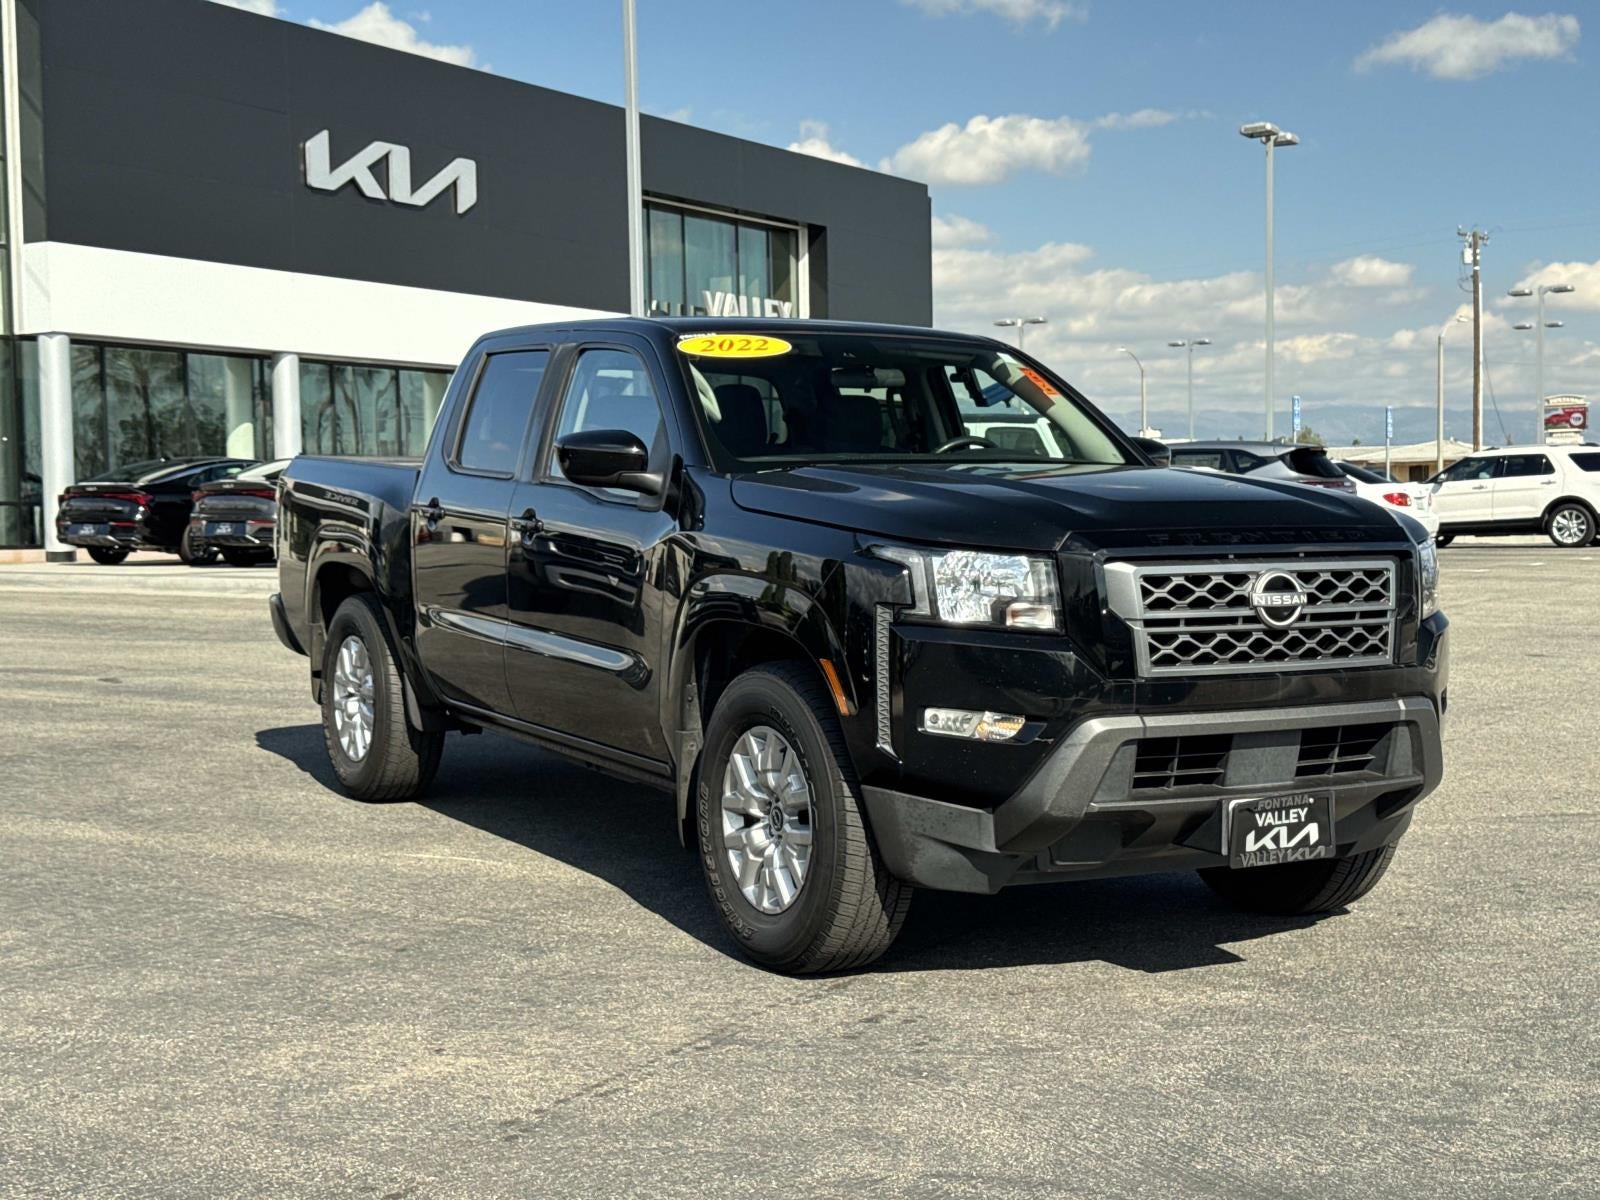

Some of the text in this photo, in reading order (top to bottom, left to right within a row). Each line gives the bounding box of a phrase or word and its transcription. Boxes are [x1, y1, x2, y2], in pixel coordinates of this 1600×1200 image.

[304, 129, 477, 215] KIA
[703, 290, 793, 318] VALLEY
[700, 338, 769, 352] 2022
[1254, 594, 1308, 606] NISSAN
[1257, 794, 1309, 811] FONTANA
[1255, 807, 1308, 827] VALLEY
[1245, 822, 1319, 852] KIA
[1240, 845, 1326, 868] VALLEY KIA
